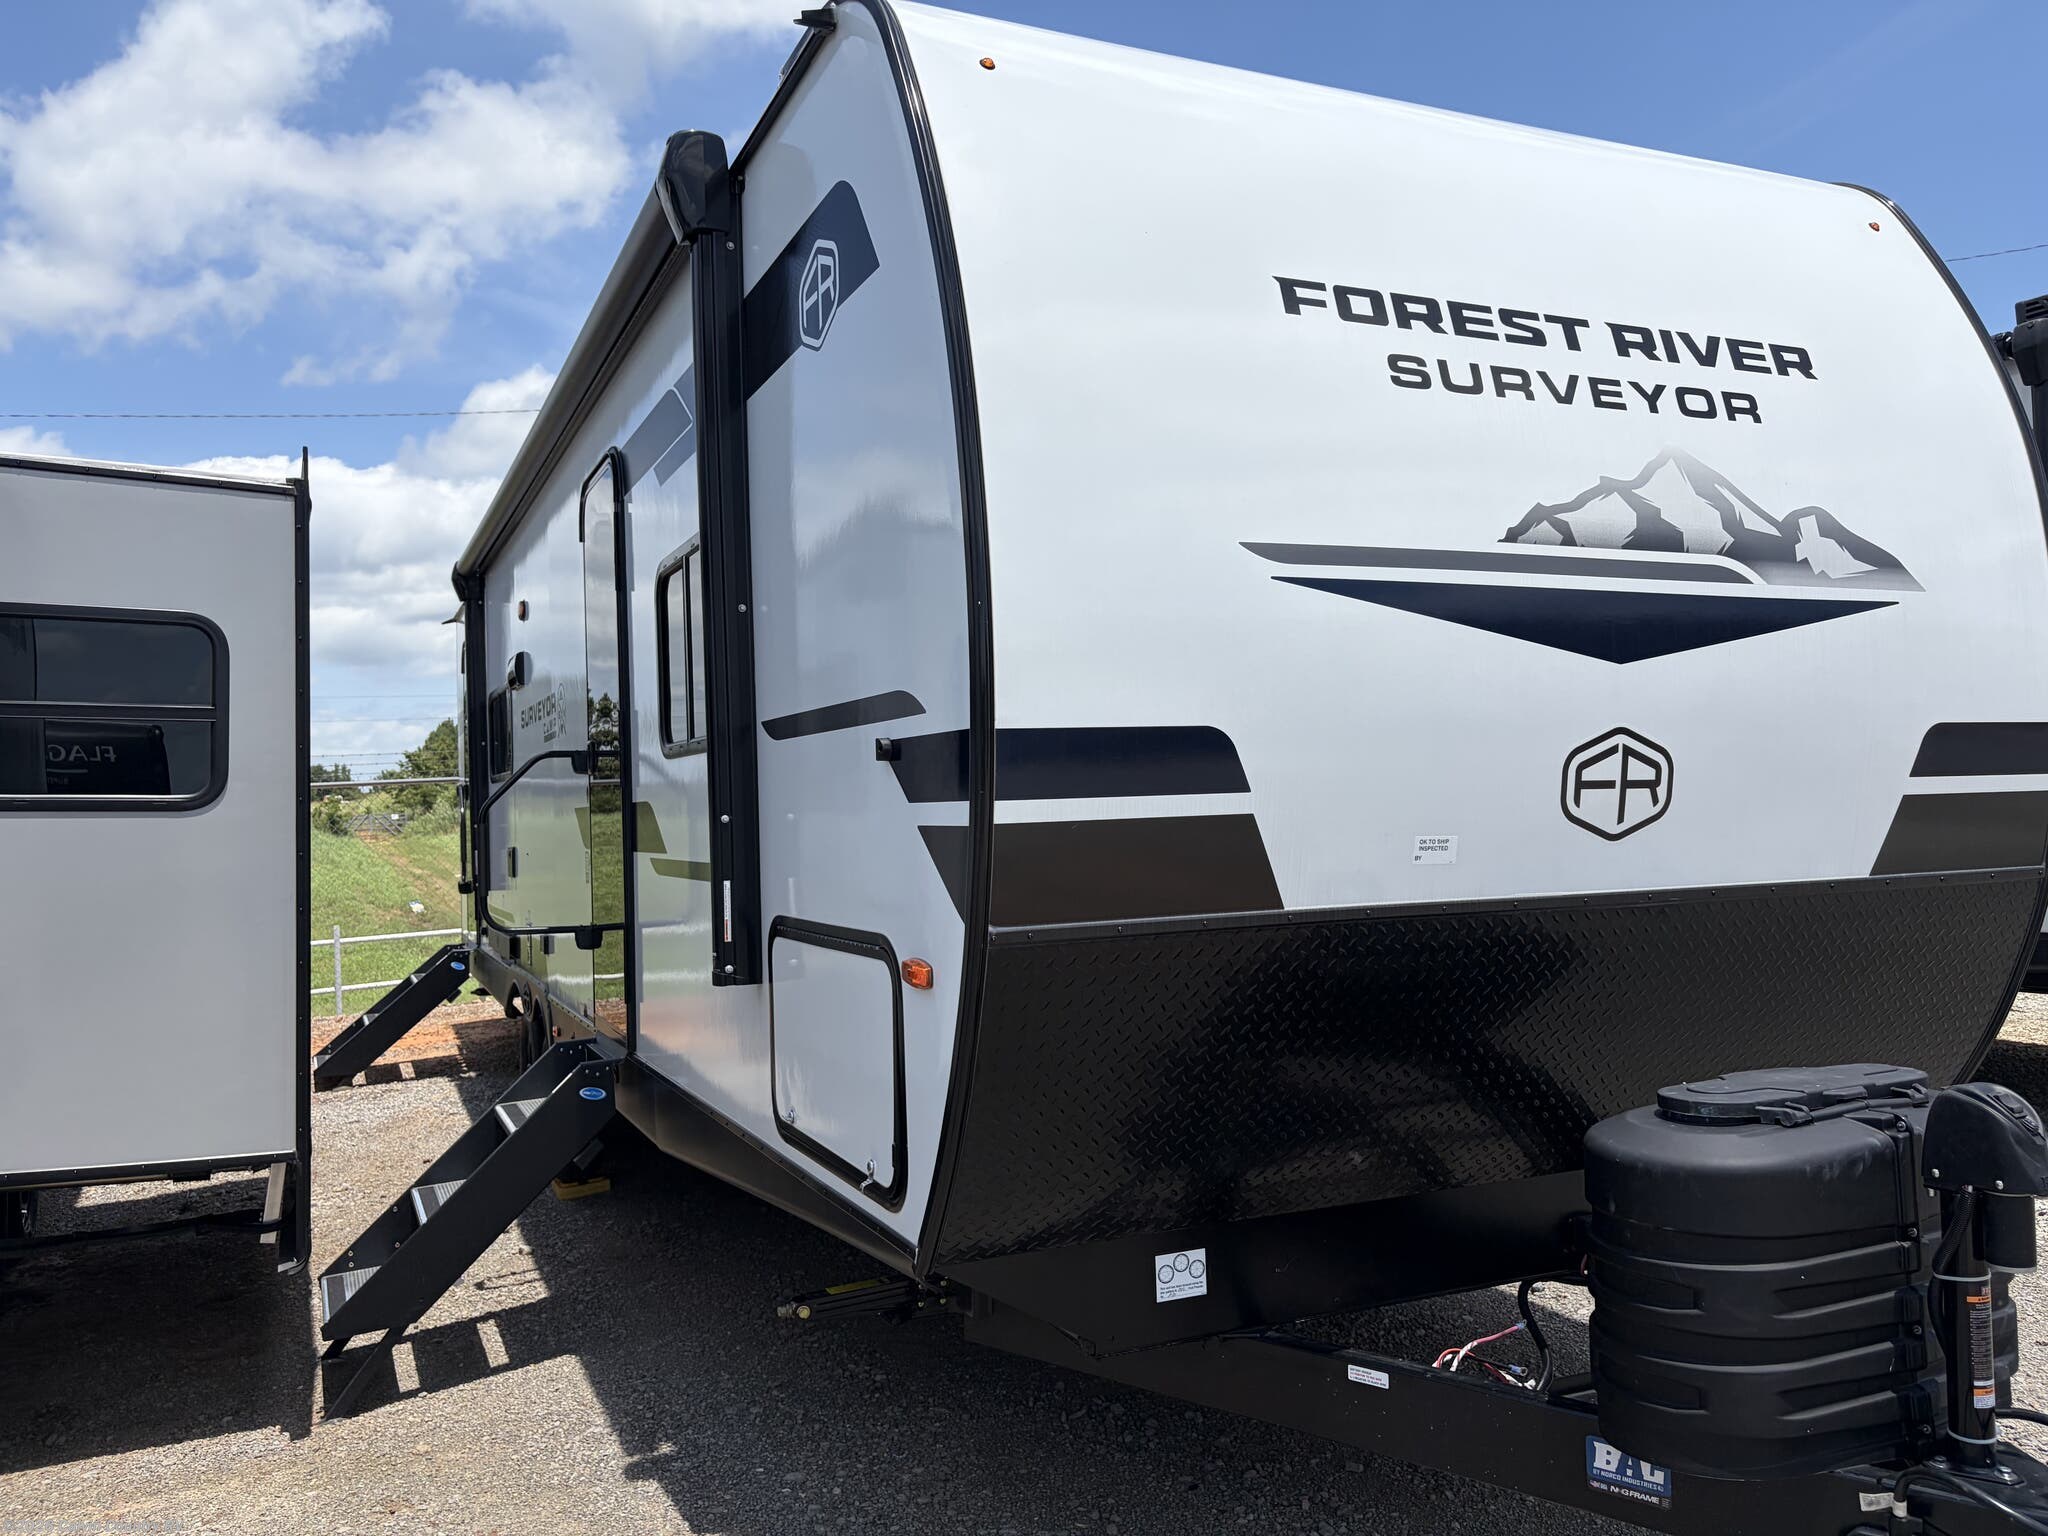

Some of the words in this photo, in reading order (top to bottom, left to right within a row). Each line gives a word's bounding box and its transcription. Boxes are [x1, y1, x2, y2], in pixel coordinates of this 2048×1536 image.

[1271, 275, 1590, 352] FOREST
[1604, 322, 1818, 381] RIVER
[1387, 353, 1763, 424] SURVEYOR
[520, 693, 557, 729] SURVEYOR
[1601, 1470, 1621, 1481] NORCO
[1622, 1476, 1659, 1490] INDUSTRIES
